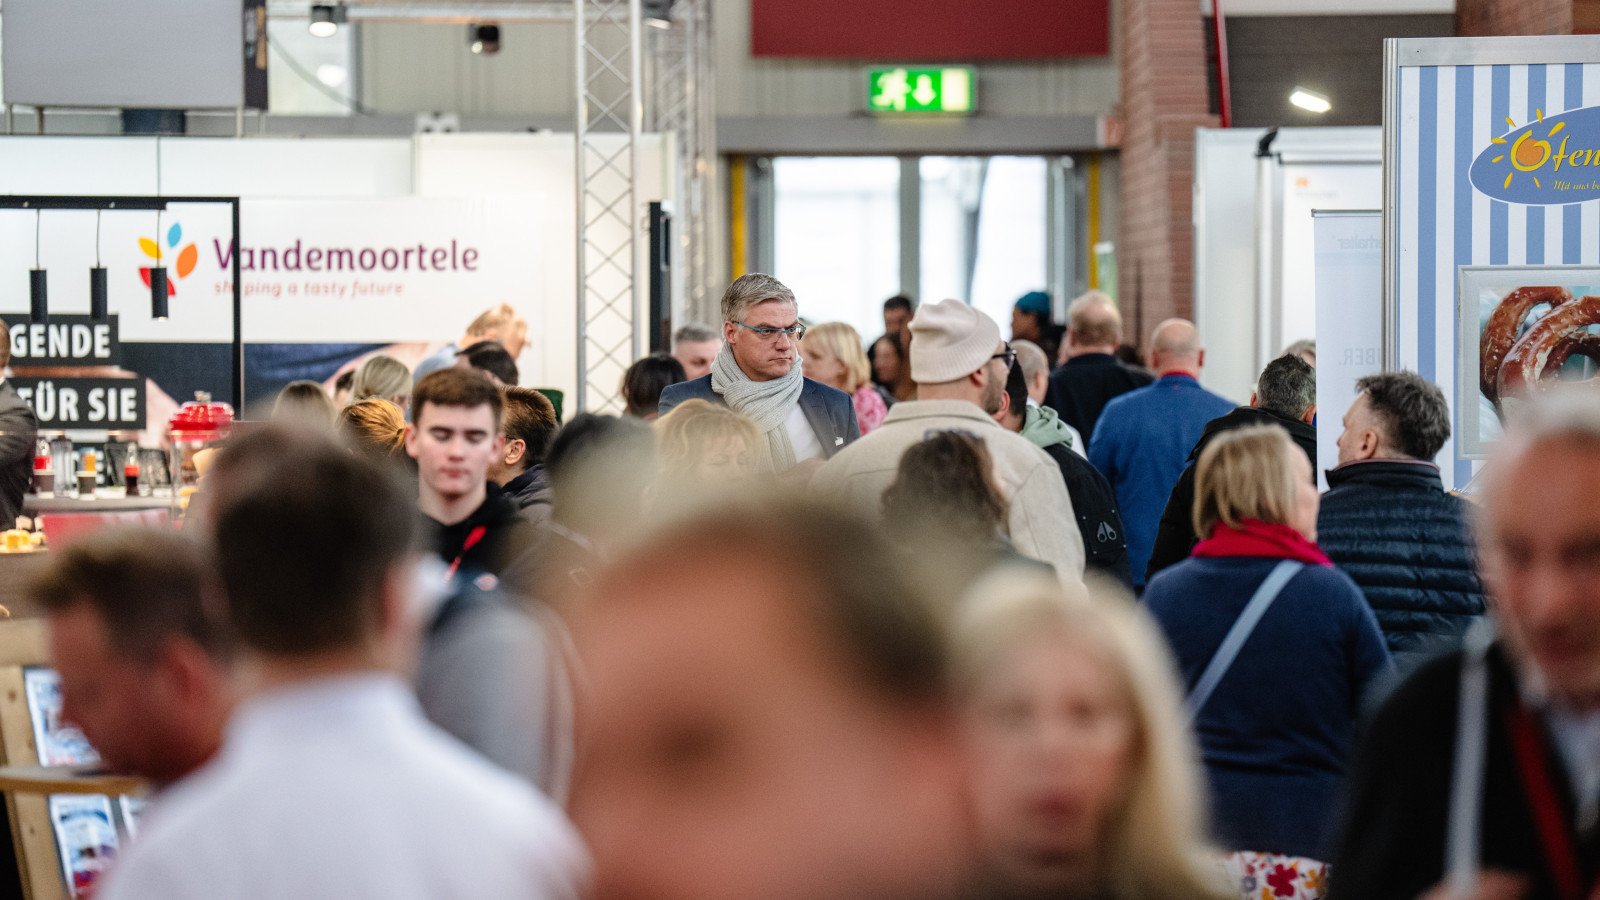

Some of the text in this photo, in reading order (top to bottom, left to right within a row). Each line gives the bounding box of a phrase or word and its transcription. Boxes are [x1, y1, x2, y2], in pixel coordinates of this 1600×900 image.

[213, 238, 479, 271] Vandemoortele
[214, 280, 403, 299] shping a tasty future
[9, 323, 111, 358] GENDE
[88, 387, 137, 421] SIE
